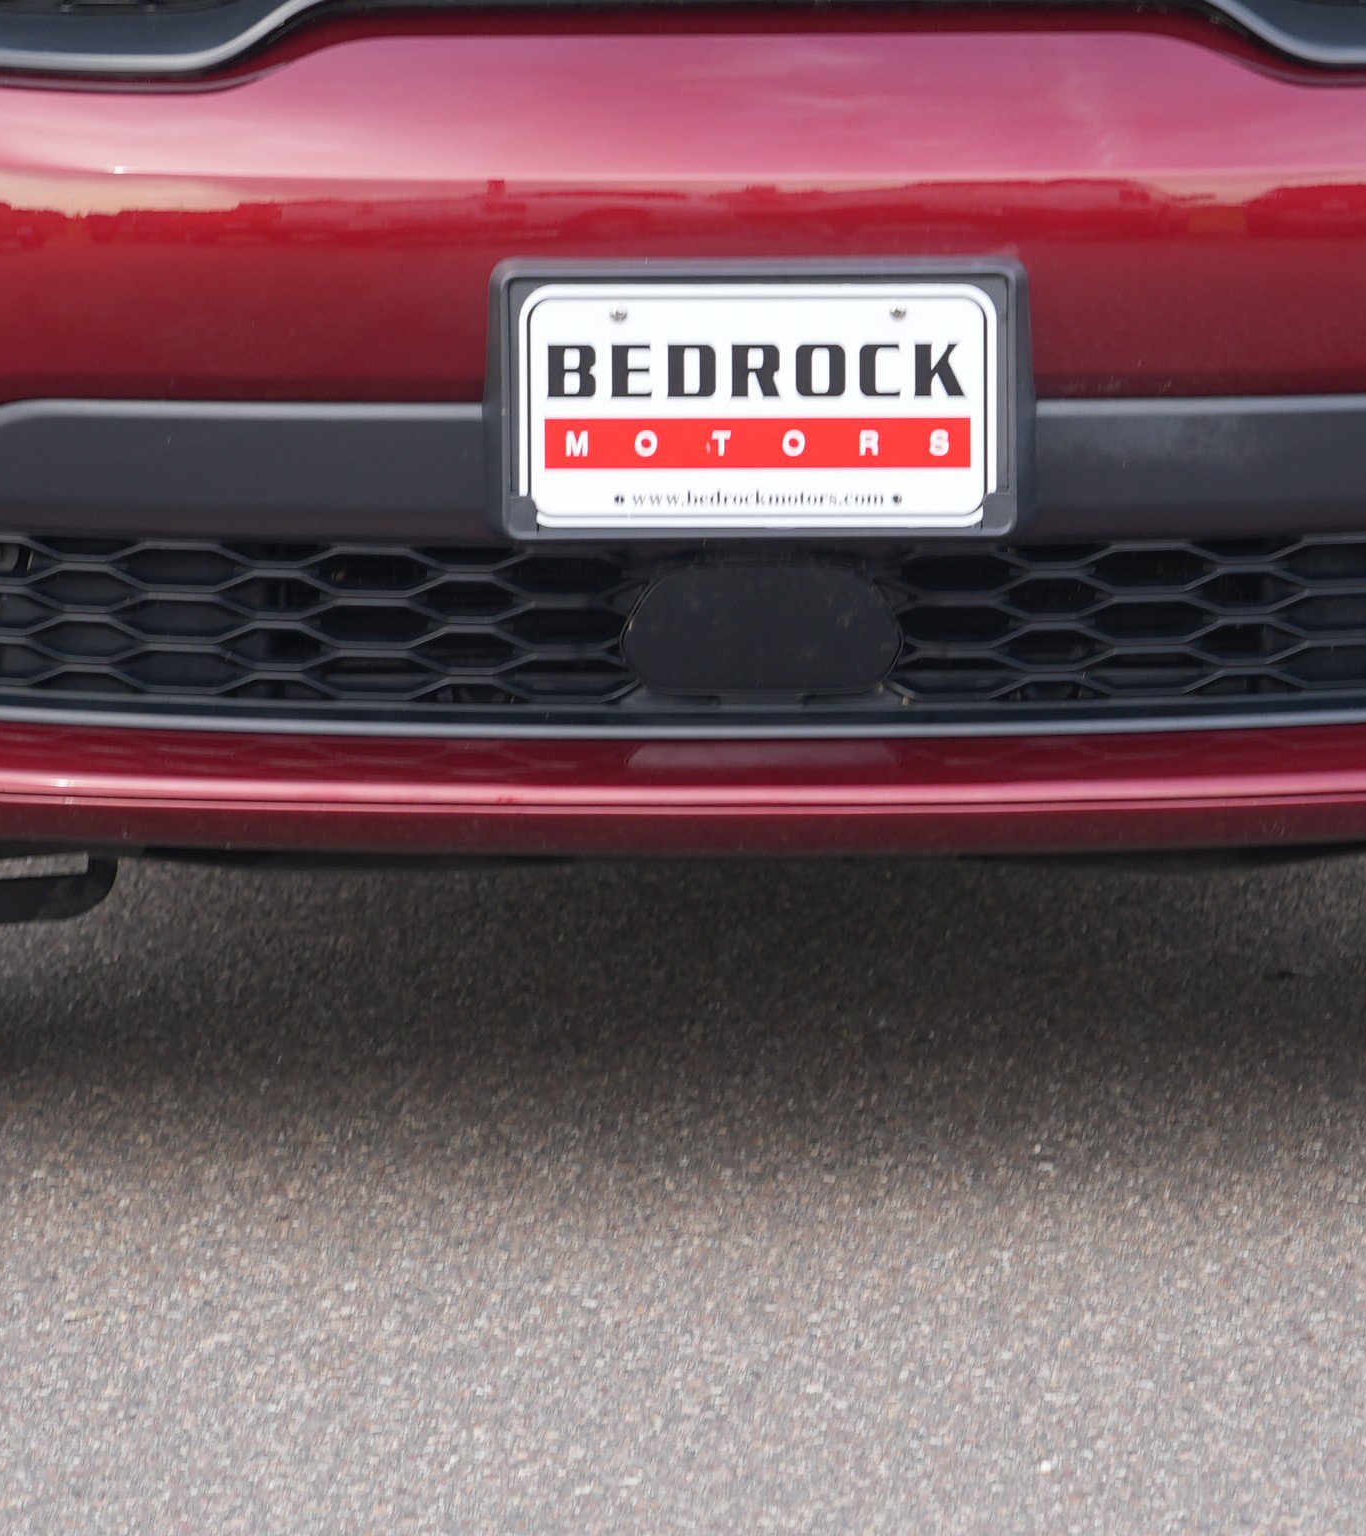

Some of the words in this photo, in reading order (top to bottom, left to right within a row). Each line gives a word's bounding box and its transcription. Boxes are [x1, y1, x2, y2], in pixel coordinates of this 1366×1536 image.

[546, 343, 966, 399] BEDROCK
[564, 428, 951, 459] MOTORS
[632, 489, 885, 506] www.bedrockmotors.com
